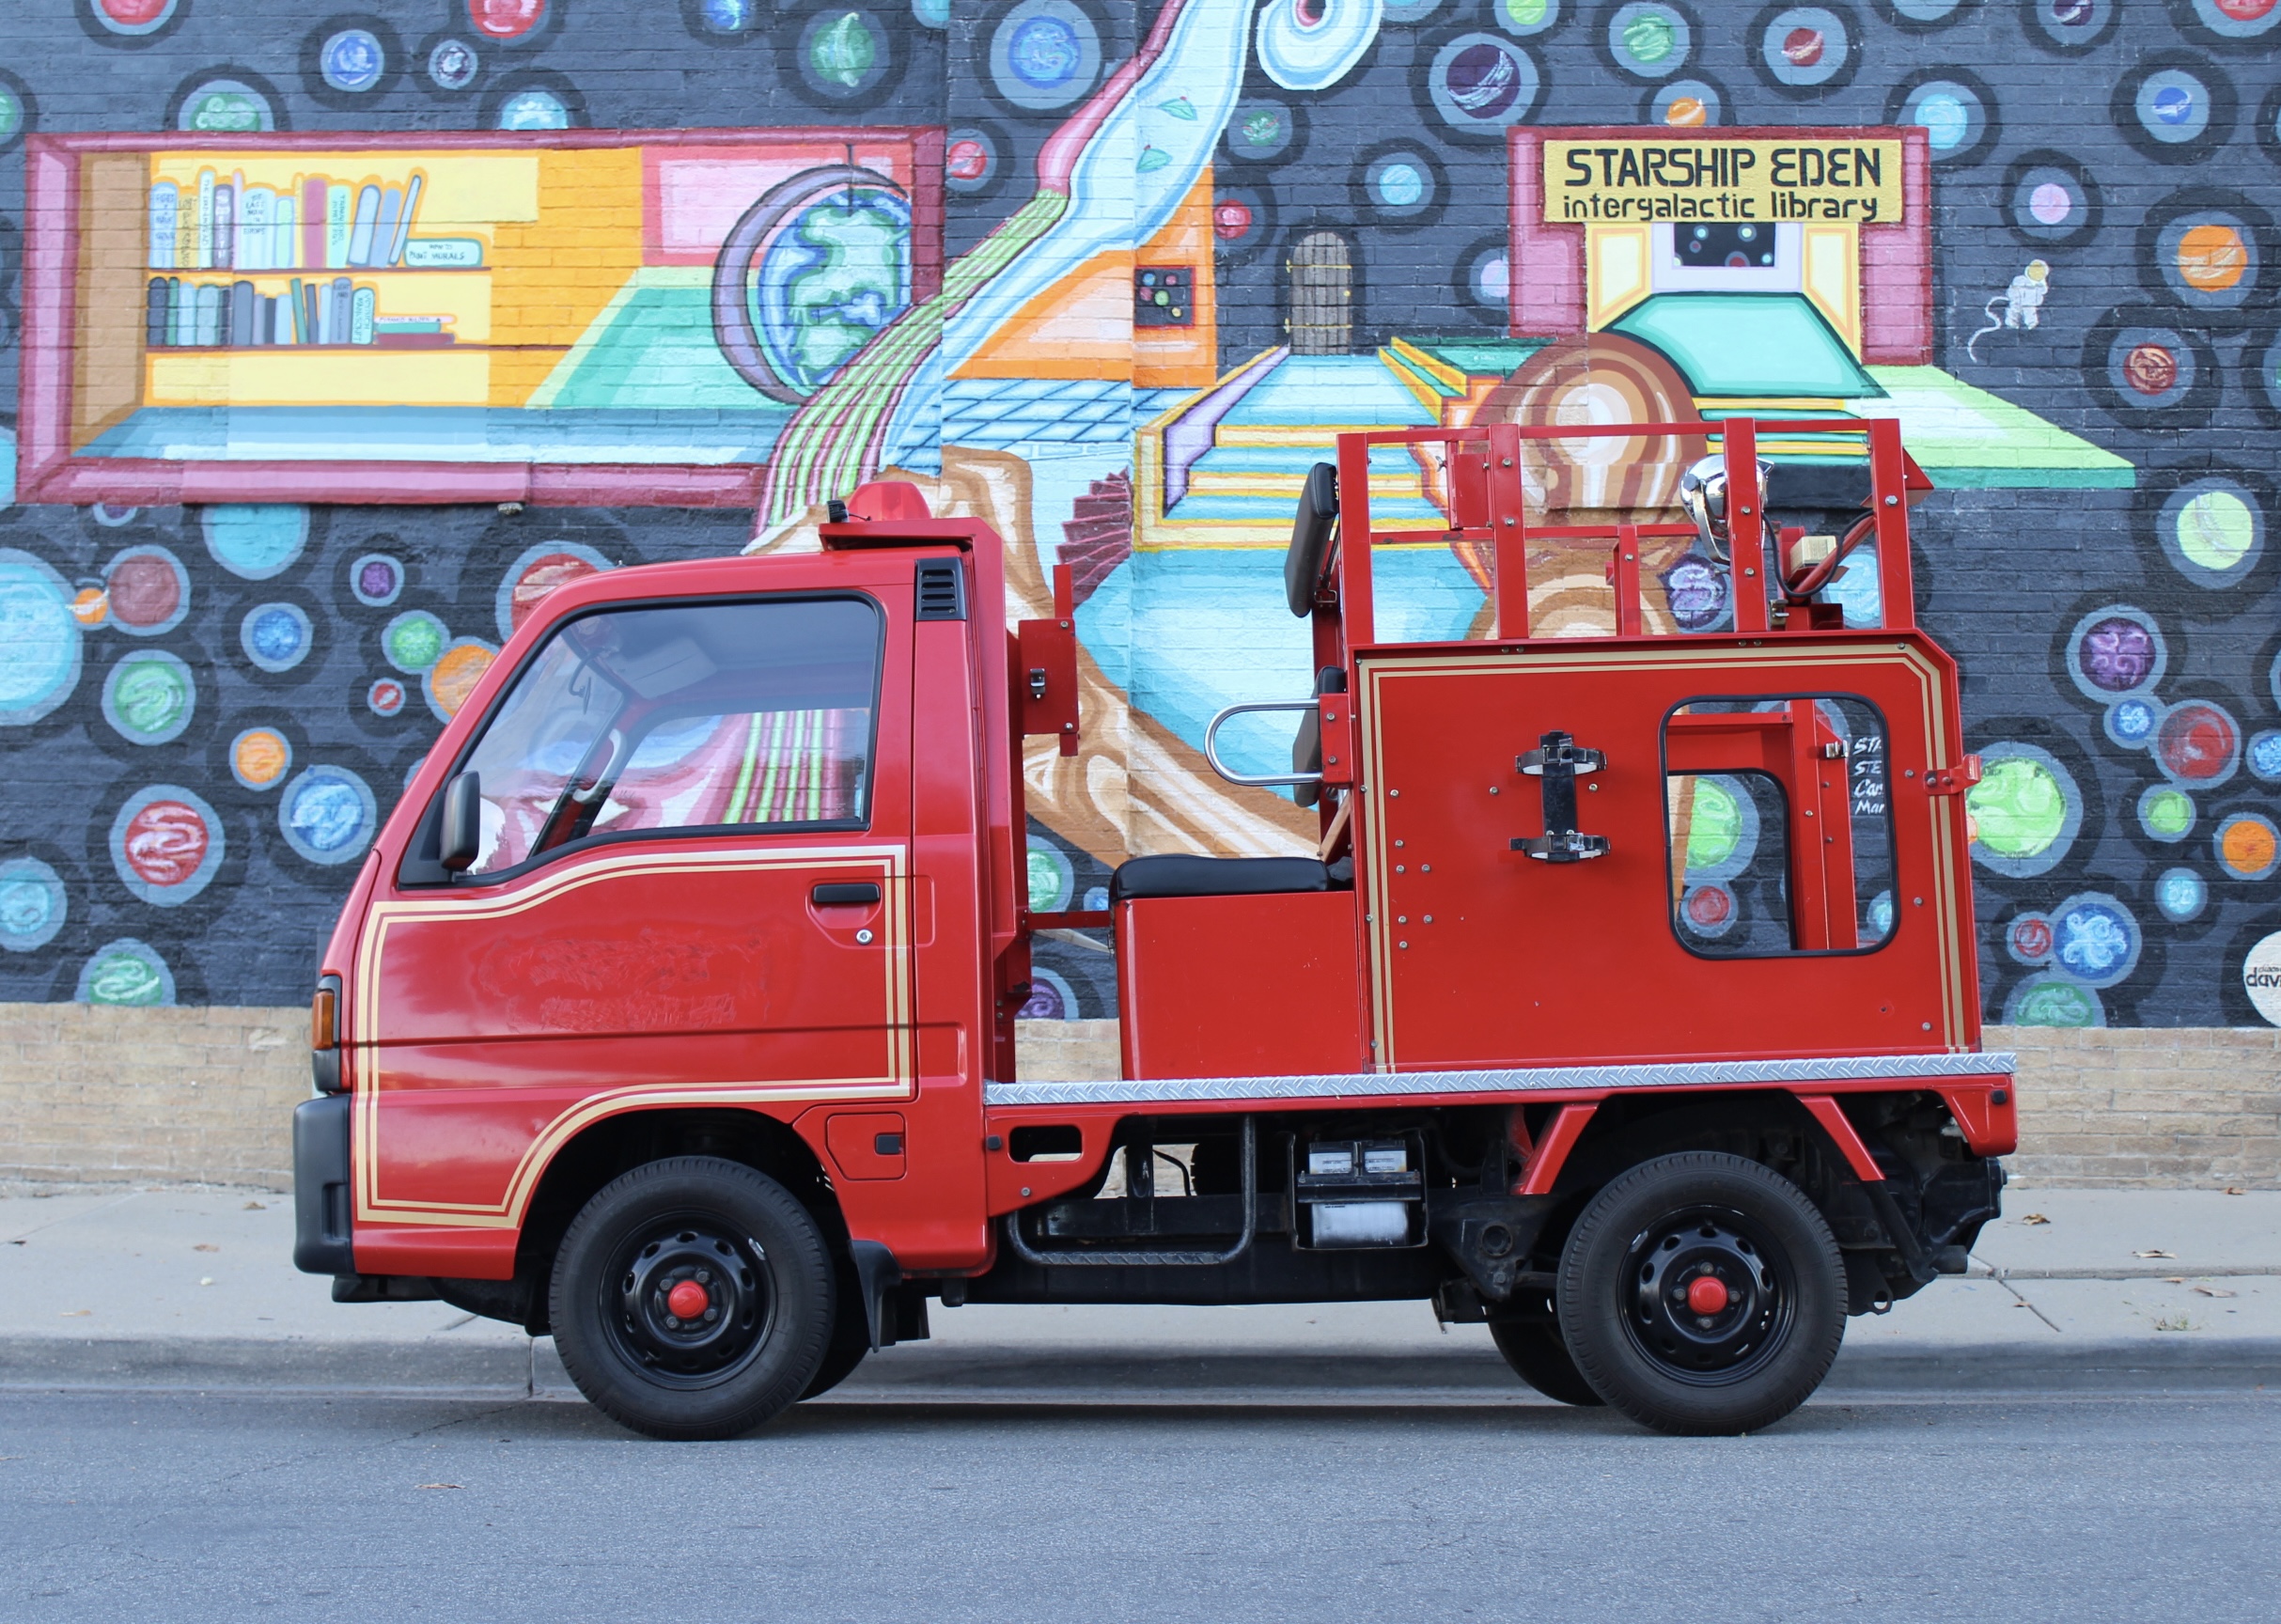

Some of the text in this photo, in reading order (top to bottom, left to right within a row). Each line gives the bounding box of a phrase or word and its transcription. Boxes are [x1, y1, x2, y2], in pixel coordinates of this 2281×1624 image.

[1564, 148, 1881, 187] STARSHIP EDEN
[1563, 191, 1878, 222] intergalactic library
[431, 251, 465, 260] MURALS
